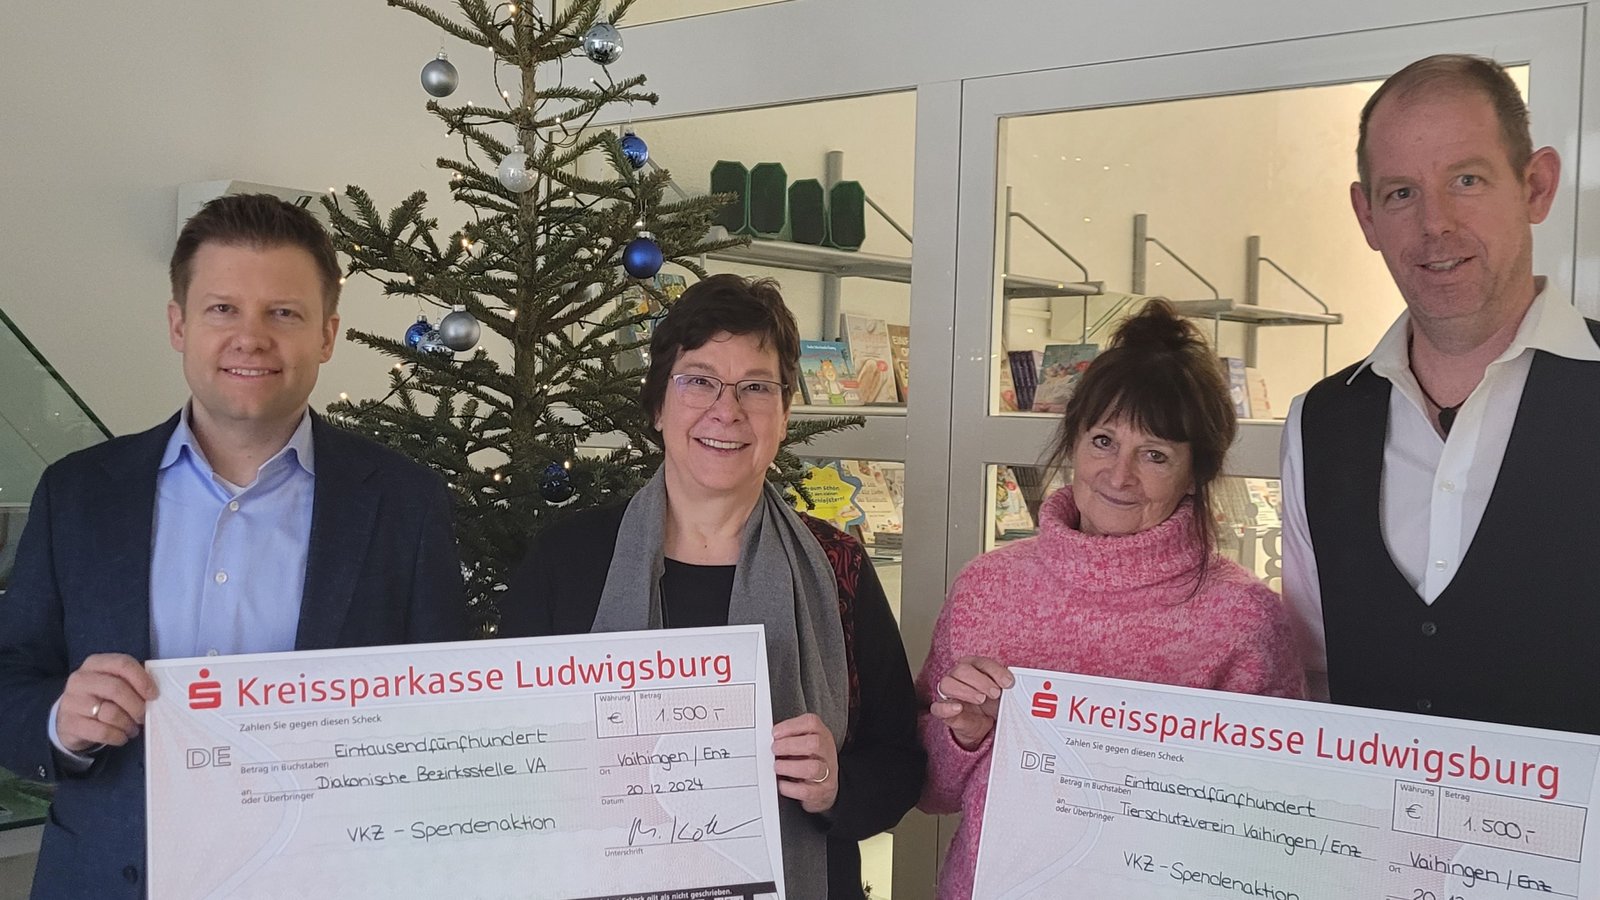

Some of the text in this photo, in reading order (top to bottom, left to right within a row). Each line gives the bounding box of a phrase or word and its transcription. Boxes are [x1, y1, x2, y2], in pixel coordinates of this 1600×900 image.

[238, 665, 504, 708] Kreissparkasse
[516, 650, 733, 690] Ludwigsburg
[599, 694, 631, 702] Währung
[639, 692, 662, 701] Betrag
[239, 714, 382, 732] Zahlen Sie gegen diesen Scheck
[1065, 737, 1185, 763] Zahlen Sie gegen diesen Scheck
[1068, 695, 1305, 755] Kreissparkasse
[1316, 727, 1559, 800] Ludwigsburg
[186, 745, 232, 770] DE
[617, 749, 689, 771] Vaihingen
[703, 746, 731, 760] Enz
[1020, 750, 1057, 774] DE
[240, 760, 330, 775] Betrag in Buchstaben
[315, 757, 547, 790] Diakonische Bezirksstelle VA
[599, 768, 611, 776] Ort
[241, 789, 252, 797] an
[626, 777, 704, 796] 20.12.2024
[1060, 776, 1132, 796] Betrag in Buchstaben
[1400, 783, 1435, 797] Währung
[241, 791, 315, 805] oder Überbringer
[601, 797, 624, 806] Datum
[1445, 790, 1471, 802] Betrag
[1055, 805, 1115, 822] oder Überbringer
[1120, 800, 1235, 836] Tierschutzverein
[1405, 803, 1424, 820] €
[346, 824, 385, 843] VKZ
[411, 815, 556, 842] Spendenaktion
[604, 847, 644, 858] Unterschrift
[1123, 850, 1154, 873] VKZ
[1388, 864, 1401, 874] Ort
[1410, 851, 1500, 888] Vaihingen
[1518, 875, 1552, 893] Enz
[672, 891, 689, 900] nicht
[691, 888, 733, 899] geschrieben.
